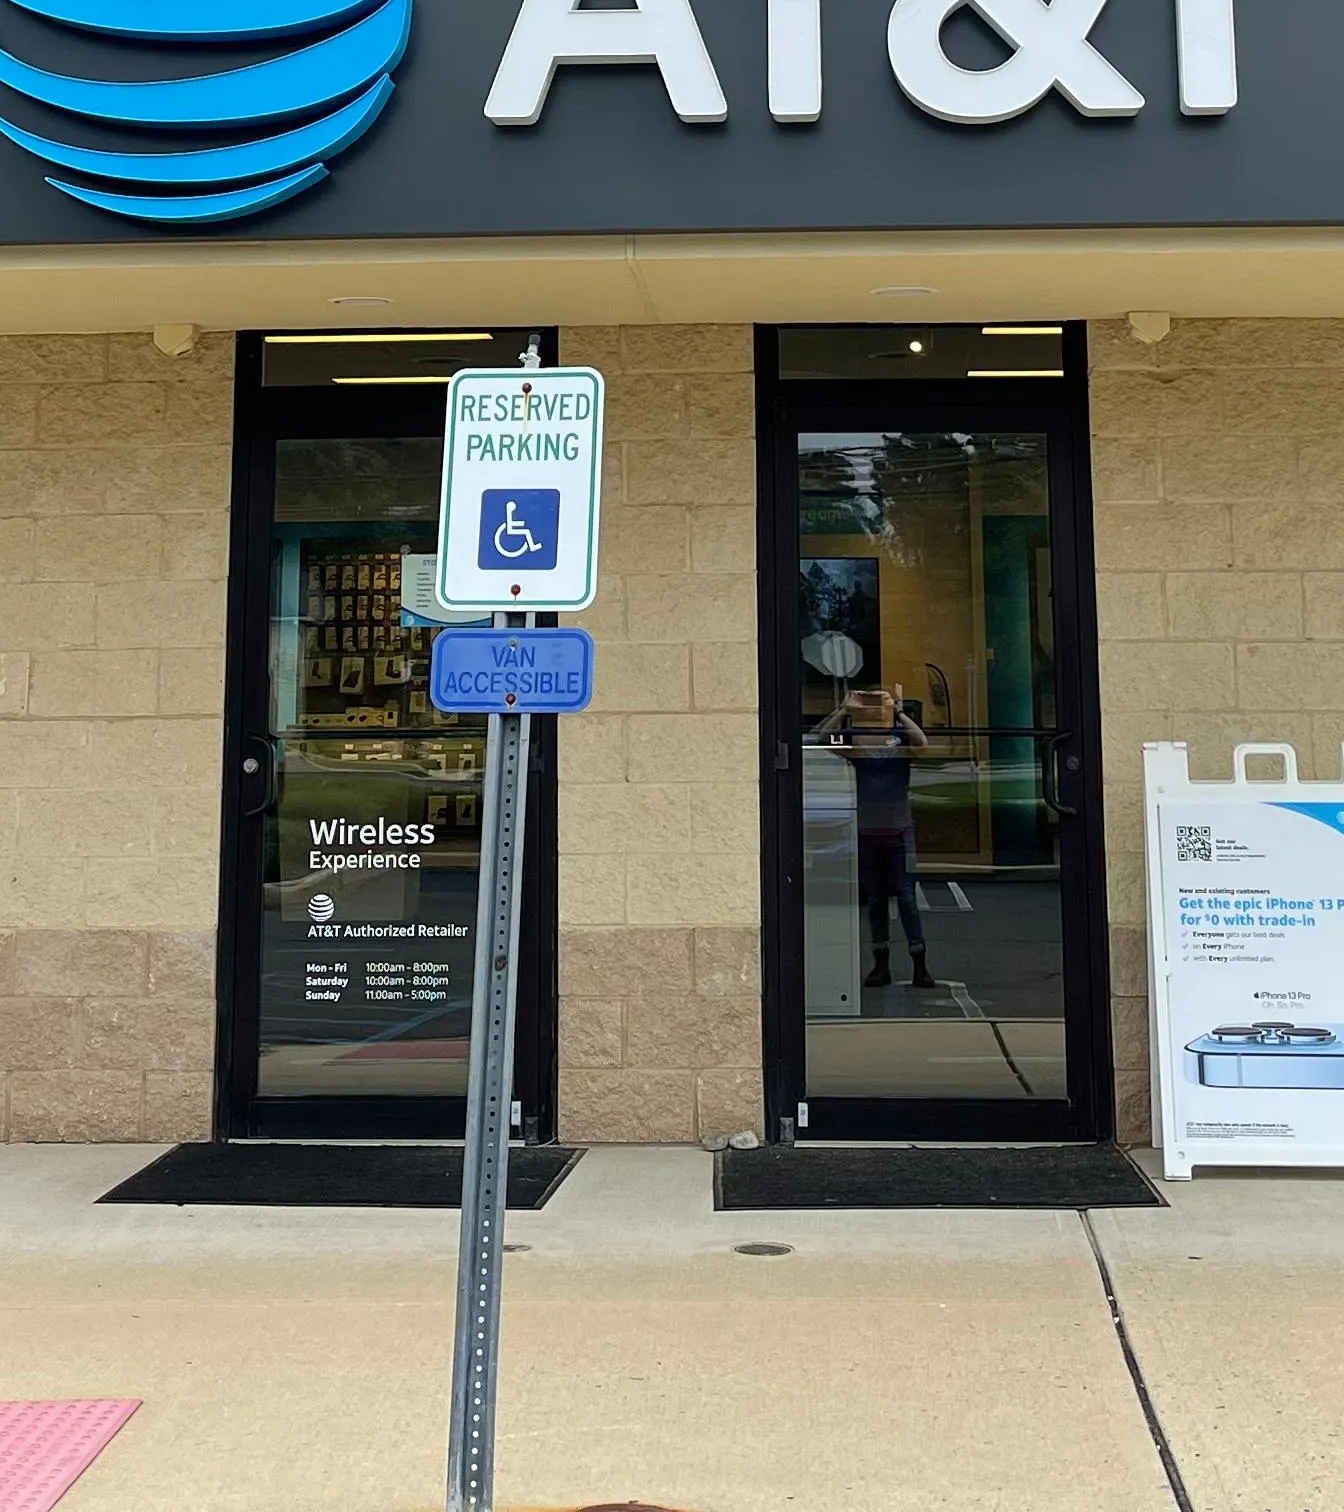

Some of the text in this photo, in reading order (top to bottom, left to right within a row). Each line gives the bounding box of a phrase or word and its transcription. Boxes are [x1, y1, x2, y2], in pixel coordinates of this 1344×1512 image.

[460, 393, 590, 422] RESERVED
[466, 432, 580, 462] PARKING
[491, 645, 536, 668] VAN
[444, 671, 580, 694] ACCESSIBLE
[309, 816, 435, 845] Wireless
[309, 849, 421, 874] Experience
[1208, 888, 1235, 896] existing
[1179, 897, 1203, 910] Get
[1207, 897, 1230, 910] the
[1234, 897, 1262, 913] epic
[1266, 898, 1314, 910] iPhone
[1320, 899, 1333, 910] 13
[1180, 914, 1316, 927] for $0 with trade-in
[307, 924, 468, 938] AT&T Authorized Retailer
[1192, 931, 1225, 939] Everyone
[1202, 943, 1222, 951] Every
[1208, 955, 1228, 963] Every
[306, 963, 327, 973] Mon
[334, 963, 347, 972] Fri
[365, 962, 405, 973] 10:00am
[412, 962, 449, 974] 8:00pm
[305, 976, 348, 988] Saturday
[365, 976, 405, 986] 10:00am
[412, 976, 449, 988] 8:00pm
[305, 990, 341, 1002] Sunday
[411, 990, 446, 1001] 5:00pm
[1260, 991, 1311, 1000] iPhone 13 Pro
